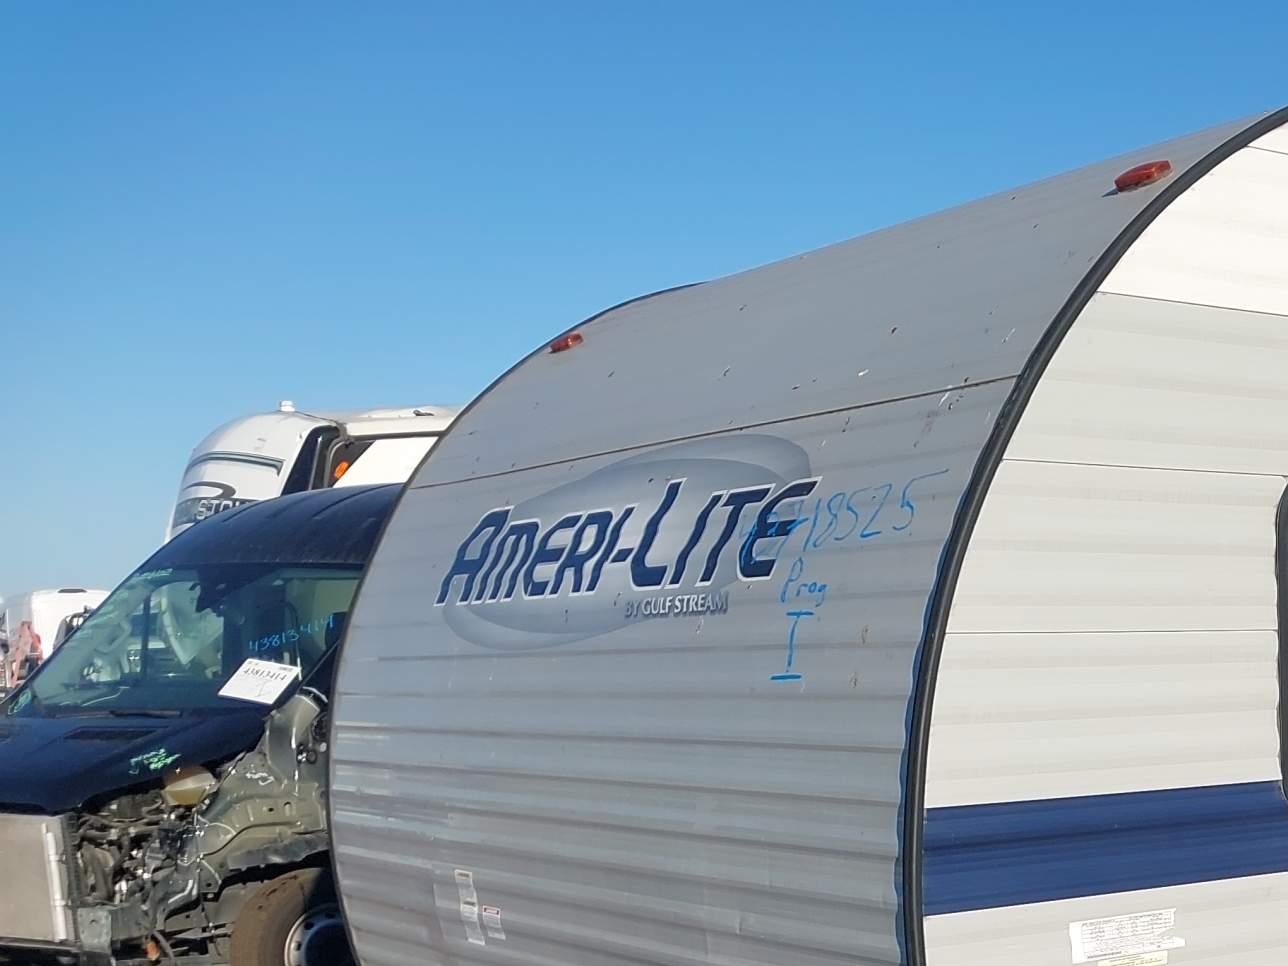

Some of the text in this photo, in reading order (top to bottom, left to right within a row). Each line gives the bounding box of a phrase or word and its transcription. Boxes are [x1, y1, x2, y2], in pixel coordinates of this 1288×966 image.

[625, 592, 729, 618] BY GULF STREAM
